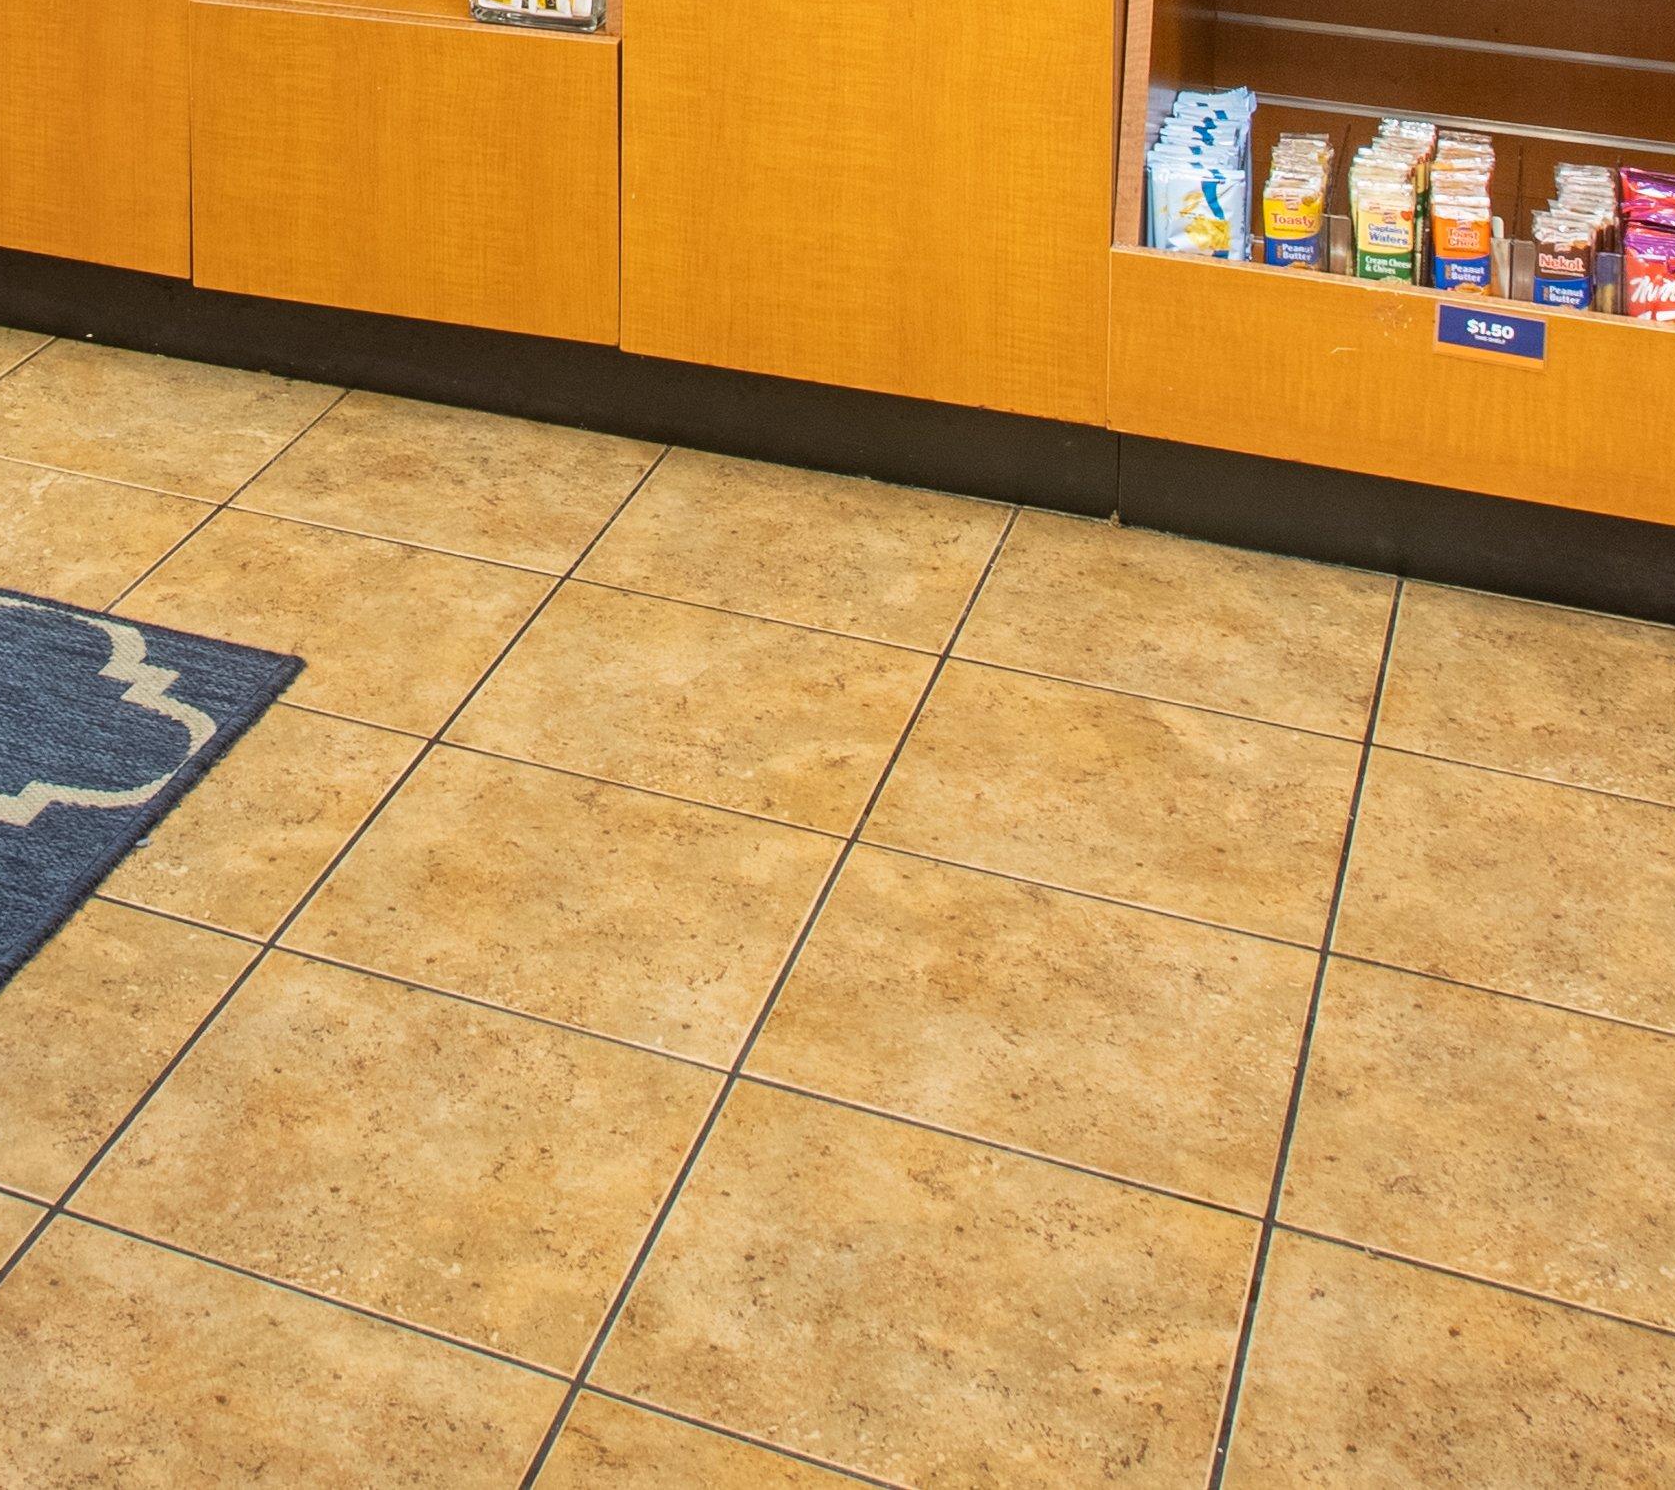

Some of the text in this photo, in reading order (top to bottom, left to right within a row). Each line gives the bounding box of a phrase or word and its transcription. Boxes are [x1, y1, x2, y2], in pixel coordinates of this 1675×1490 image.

[1271, 213, 1315, 228] Toasty
[1368, 233, 1408, 246] Wafers
[1282, 243, 1315, 255] Peanut
[1282, 251, 1311, 262] Butter
[1467, 319, 1515, 340] $1.50
